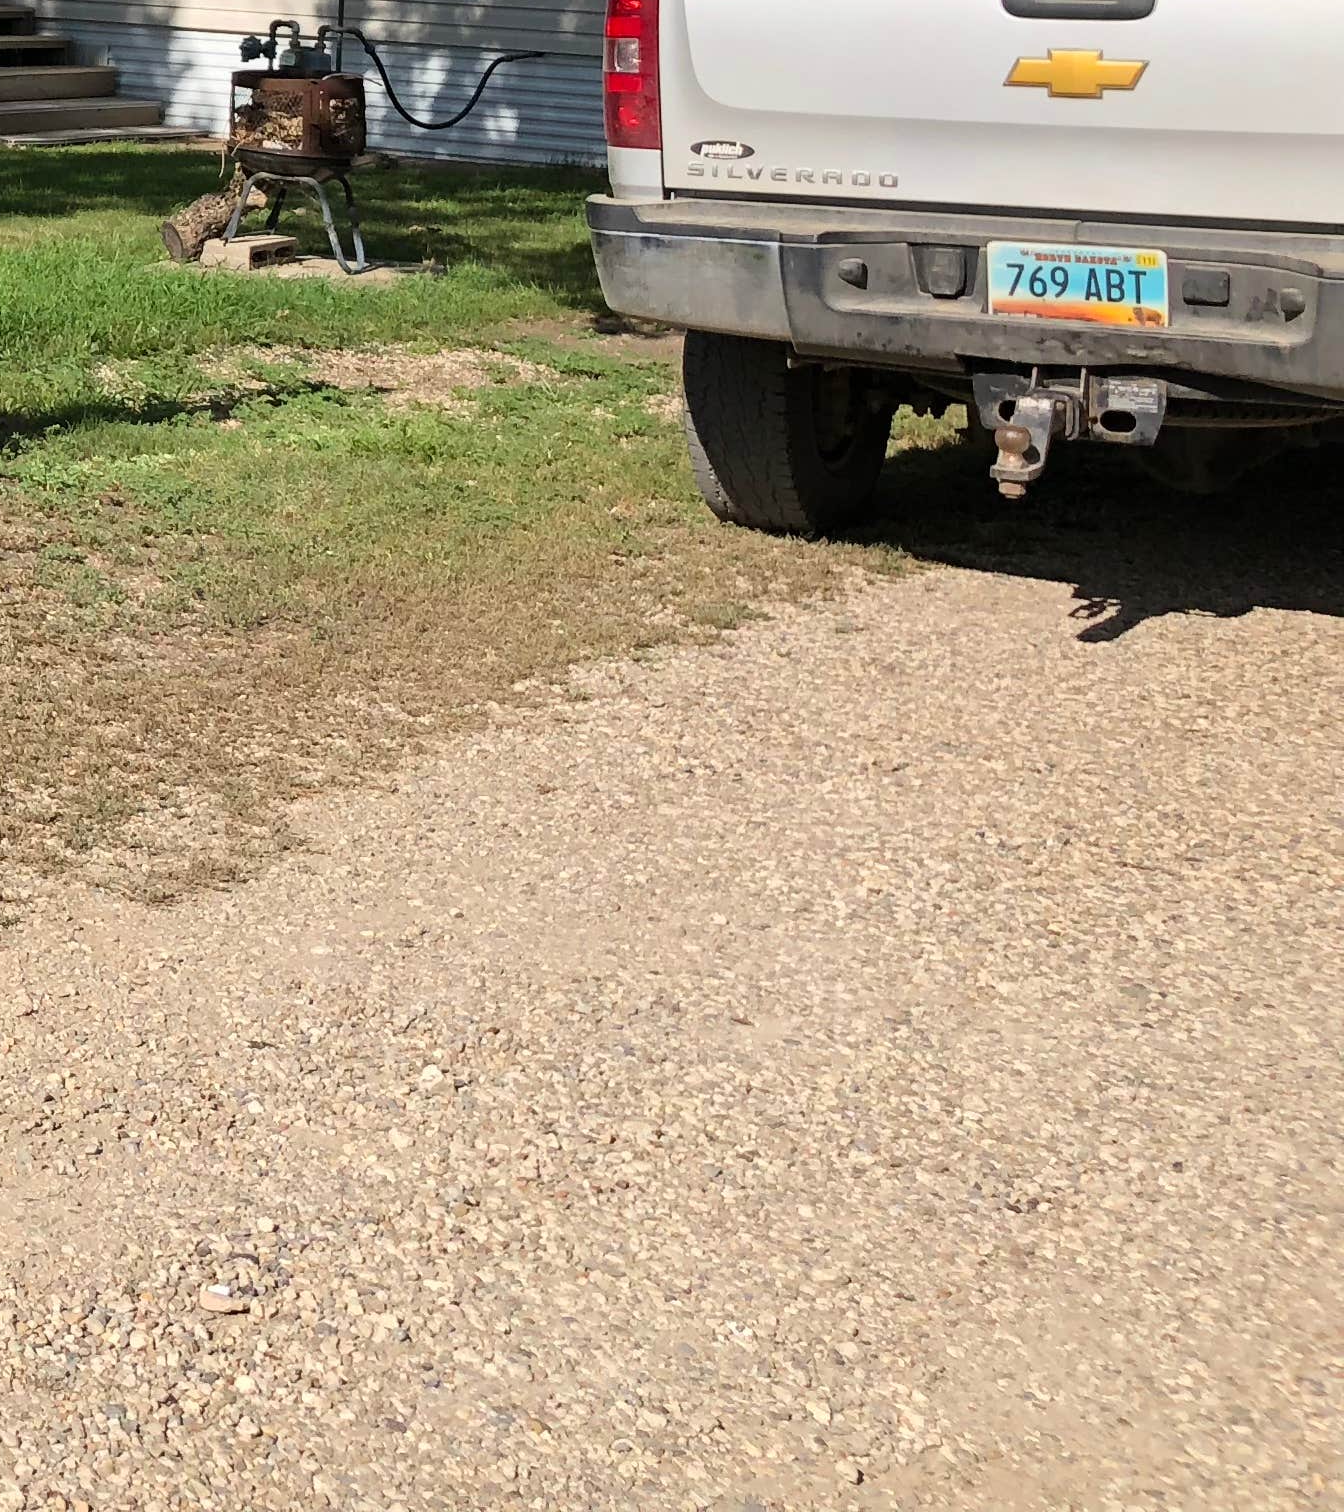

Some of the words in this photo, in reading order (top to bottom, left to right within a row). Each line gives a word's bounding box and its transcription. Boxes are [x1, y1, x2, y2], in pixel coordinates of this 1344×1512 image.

[686, 160, 899, 188] SILVERADO
[1035, 252, 1072, 264] NORTH
[1075, 254, 1119, 266] DAKOTA
[1006, 262, 1069, 299] 769
[1085, 267, 1147, 305] ABT
